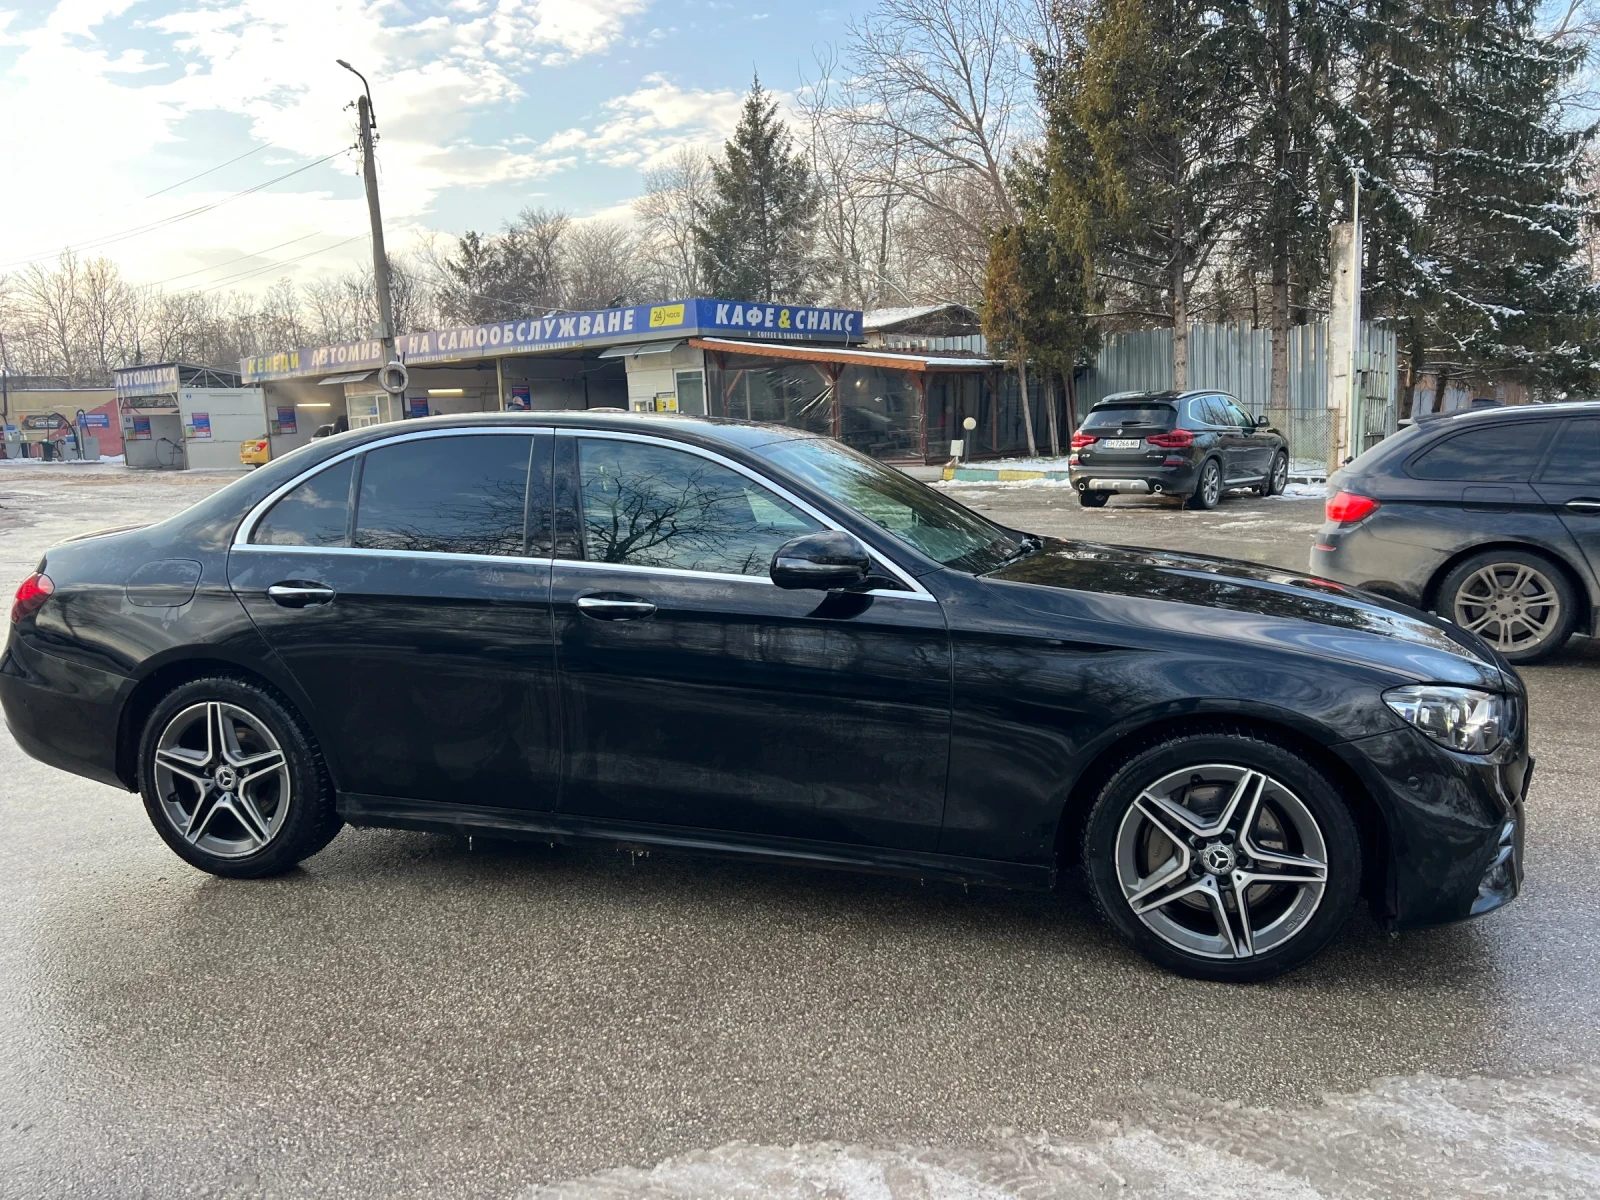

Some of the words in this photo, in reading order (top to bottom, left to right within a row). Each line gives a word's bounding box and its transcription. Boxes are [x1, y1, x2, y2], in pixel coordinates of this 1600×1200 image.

[653, 310, 663, 322] 24
[715, 303, 775, 328] КАФЕ
[778, 308, 791, 329] &
[795, 309, 855, 332] СНАКС
[247, 352, 300, 375] КЕНЕДИ
[311, 338, 402, 367] АВТОМИВА
[408, 335, 431, 355] НА
[437, 308, 636, 351] САМООБСЛУЖВАНЕ
[115, 366, 176, 387] АВТОМИВКА
